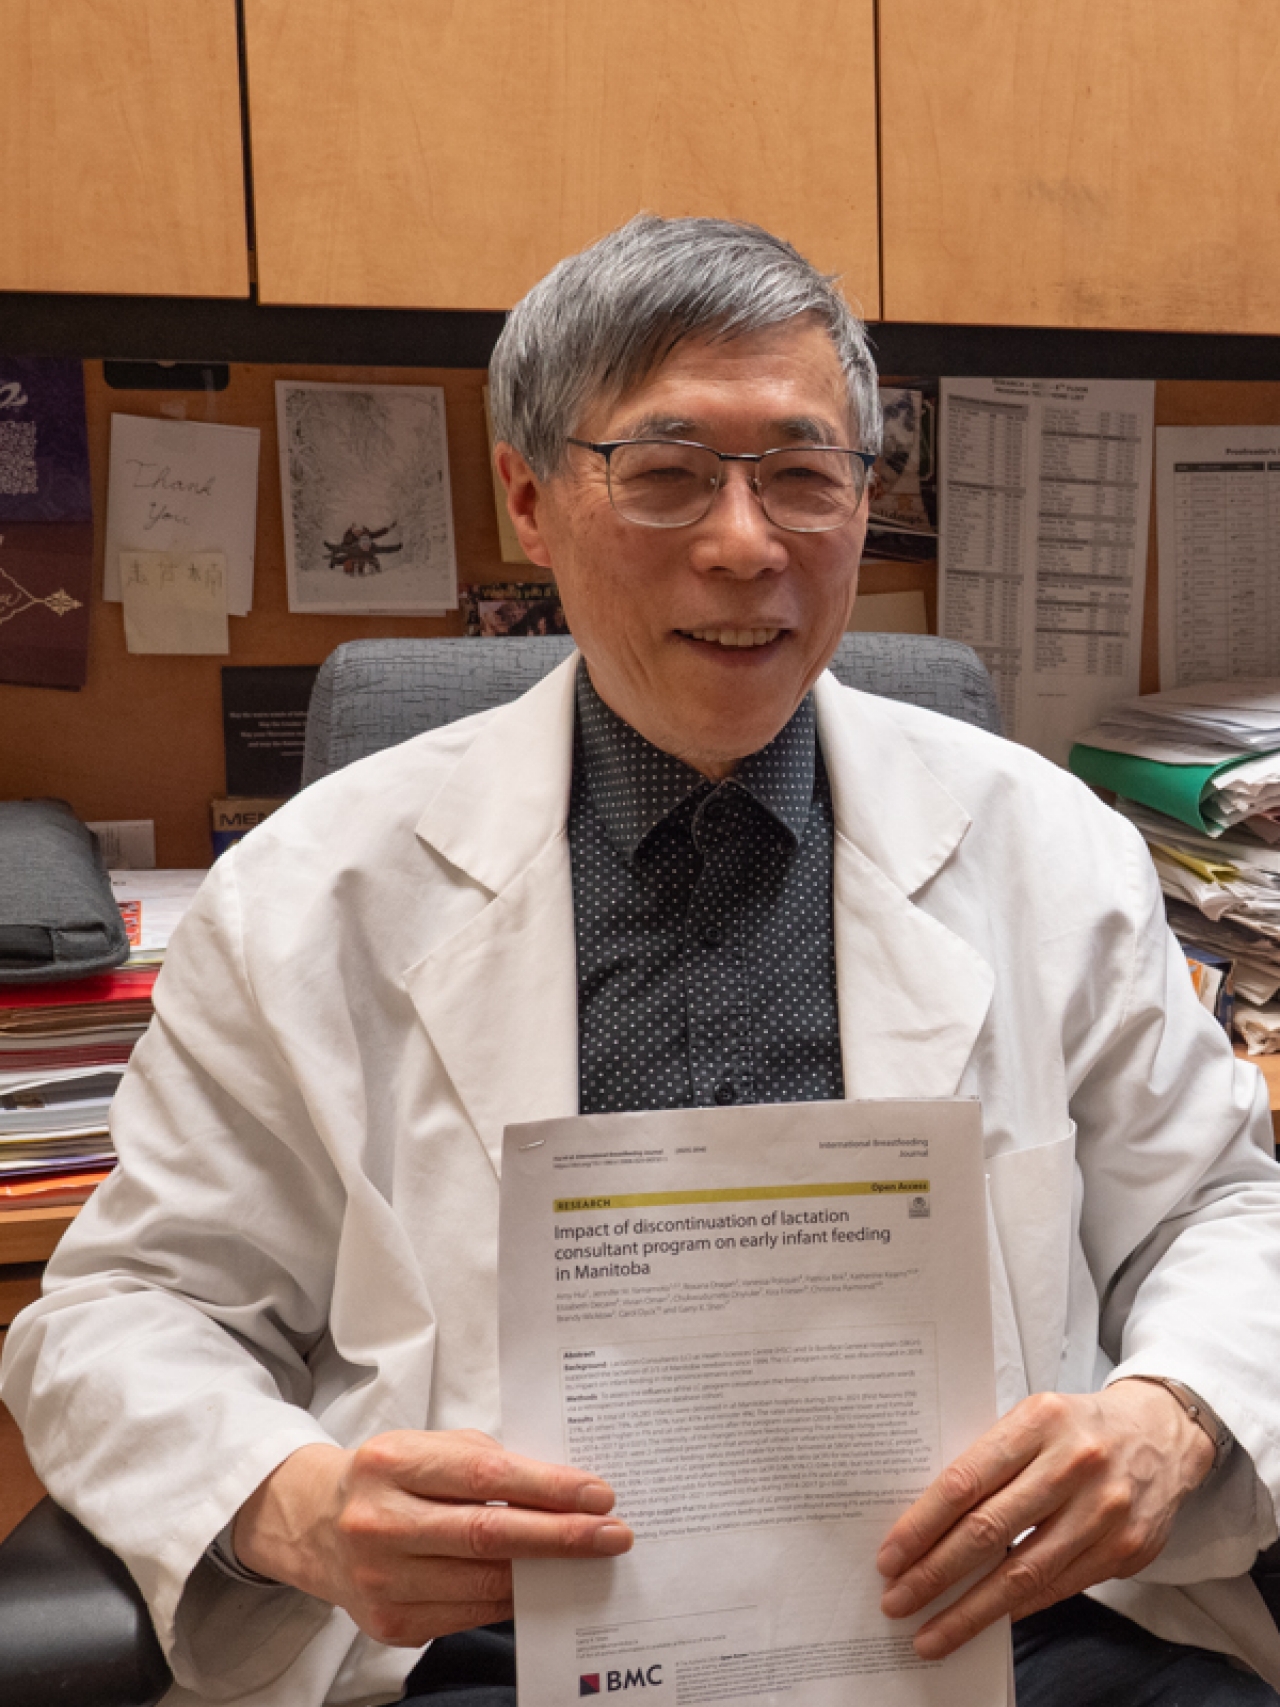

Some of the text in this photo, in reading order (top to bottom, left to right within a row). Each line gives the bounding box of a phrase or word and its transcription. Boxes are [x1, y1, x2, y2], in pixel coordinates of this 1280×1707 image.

[125, 458, 216, 496] Thank
[819, 1138, 929, 1149] International Breastfeeding
[899, 1149, 929, 1157] Journal
[871, 1182, 927, 1193] Open Access
[557, 1199, 611, 1210] RESEARCH
[554, 1208, 849, 1241] Impact of discontinuation of lactation
[554, 1227, 891, 1261] consultant program on early infant feeding
[556, 1261, 651, 1281] in Manitoba
[563, 1350, 596, 1359] Abstract
[606, 1664, 663, 1693] BMC
